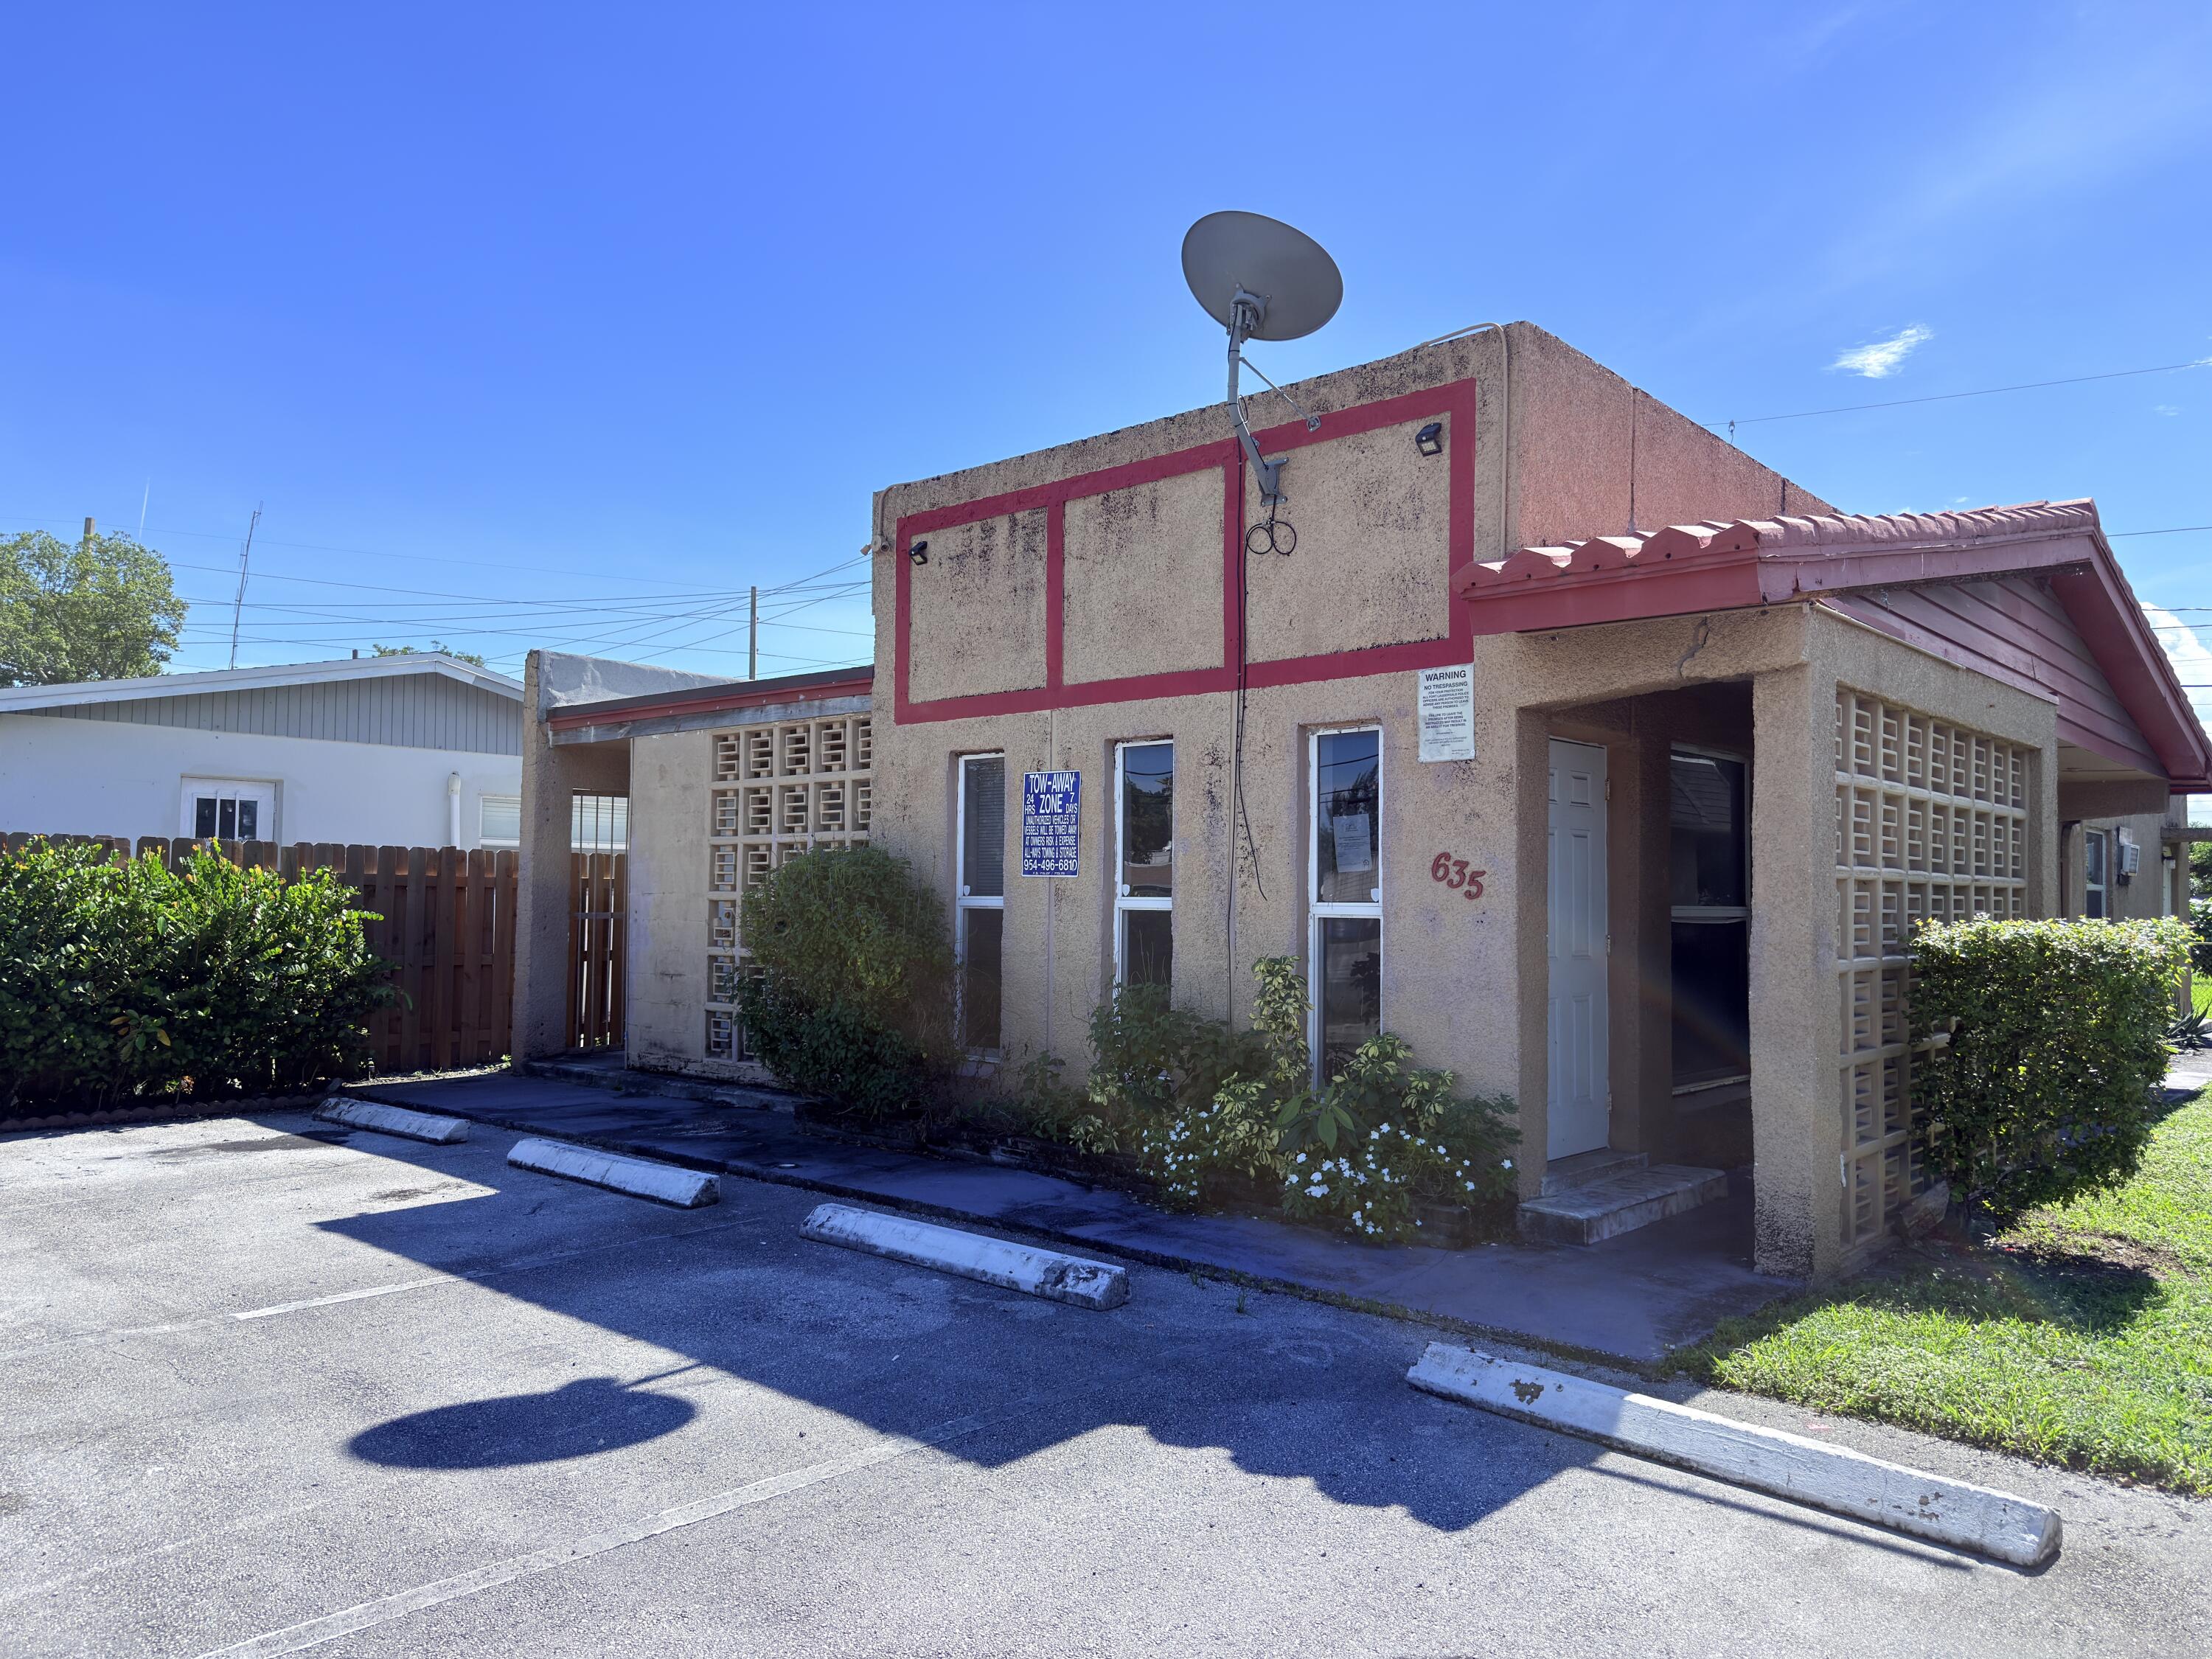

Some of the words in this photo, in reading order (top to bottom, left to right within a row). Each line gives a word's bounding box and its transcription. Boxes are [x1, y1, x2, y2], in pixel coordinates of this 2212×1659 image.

[1426, 670, 1466, 681] WARNING
[1030, 773, 1074, 793] TOW-AWAY
[1026, 794, 1034, 804] 24
[1070, 792, 1075, 803] 7
[1025, 804, 1035, 814] HRS
[1039, 794, 1062, 813] ZONE
[1066, 803, 1078, 813] DAYS
[1026, 815, 1051, 825] UNAUTHORIZED
[1052, 815, 1069, 824] VEHICLES
[1070, 815, 1075, 824] OR
[1024, 825, 1039, 835] VESSELS
[1049, 825, 1053, 835] BE
[1054, 825, 1067, 835] TOWED
[1068, 825, 1077, 834] AWAY
[1025, 836, 1030, 846] AT
[1046, 836, 1054, 846] RISK
[1055, 836, 1058, 846] &
[1059, 835, 1076, 845] EXPENSE
[1041, 847, 1054, 858] TOWING
[1056, 847, 1058, 858] &
[1060, 847, 1077, 858] STORAGE
[1024, 859, 1077, 871] 954-496-6810
[1432, 852, 1486, 900] 635
